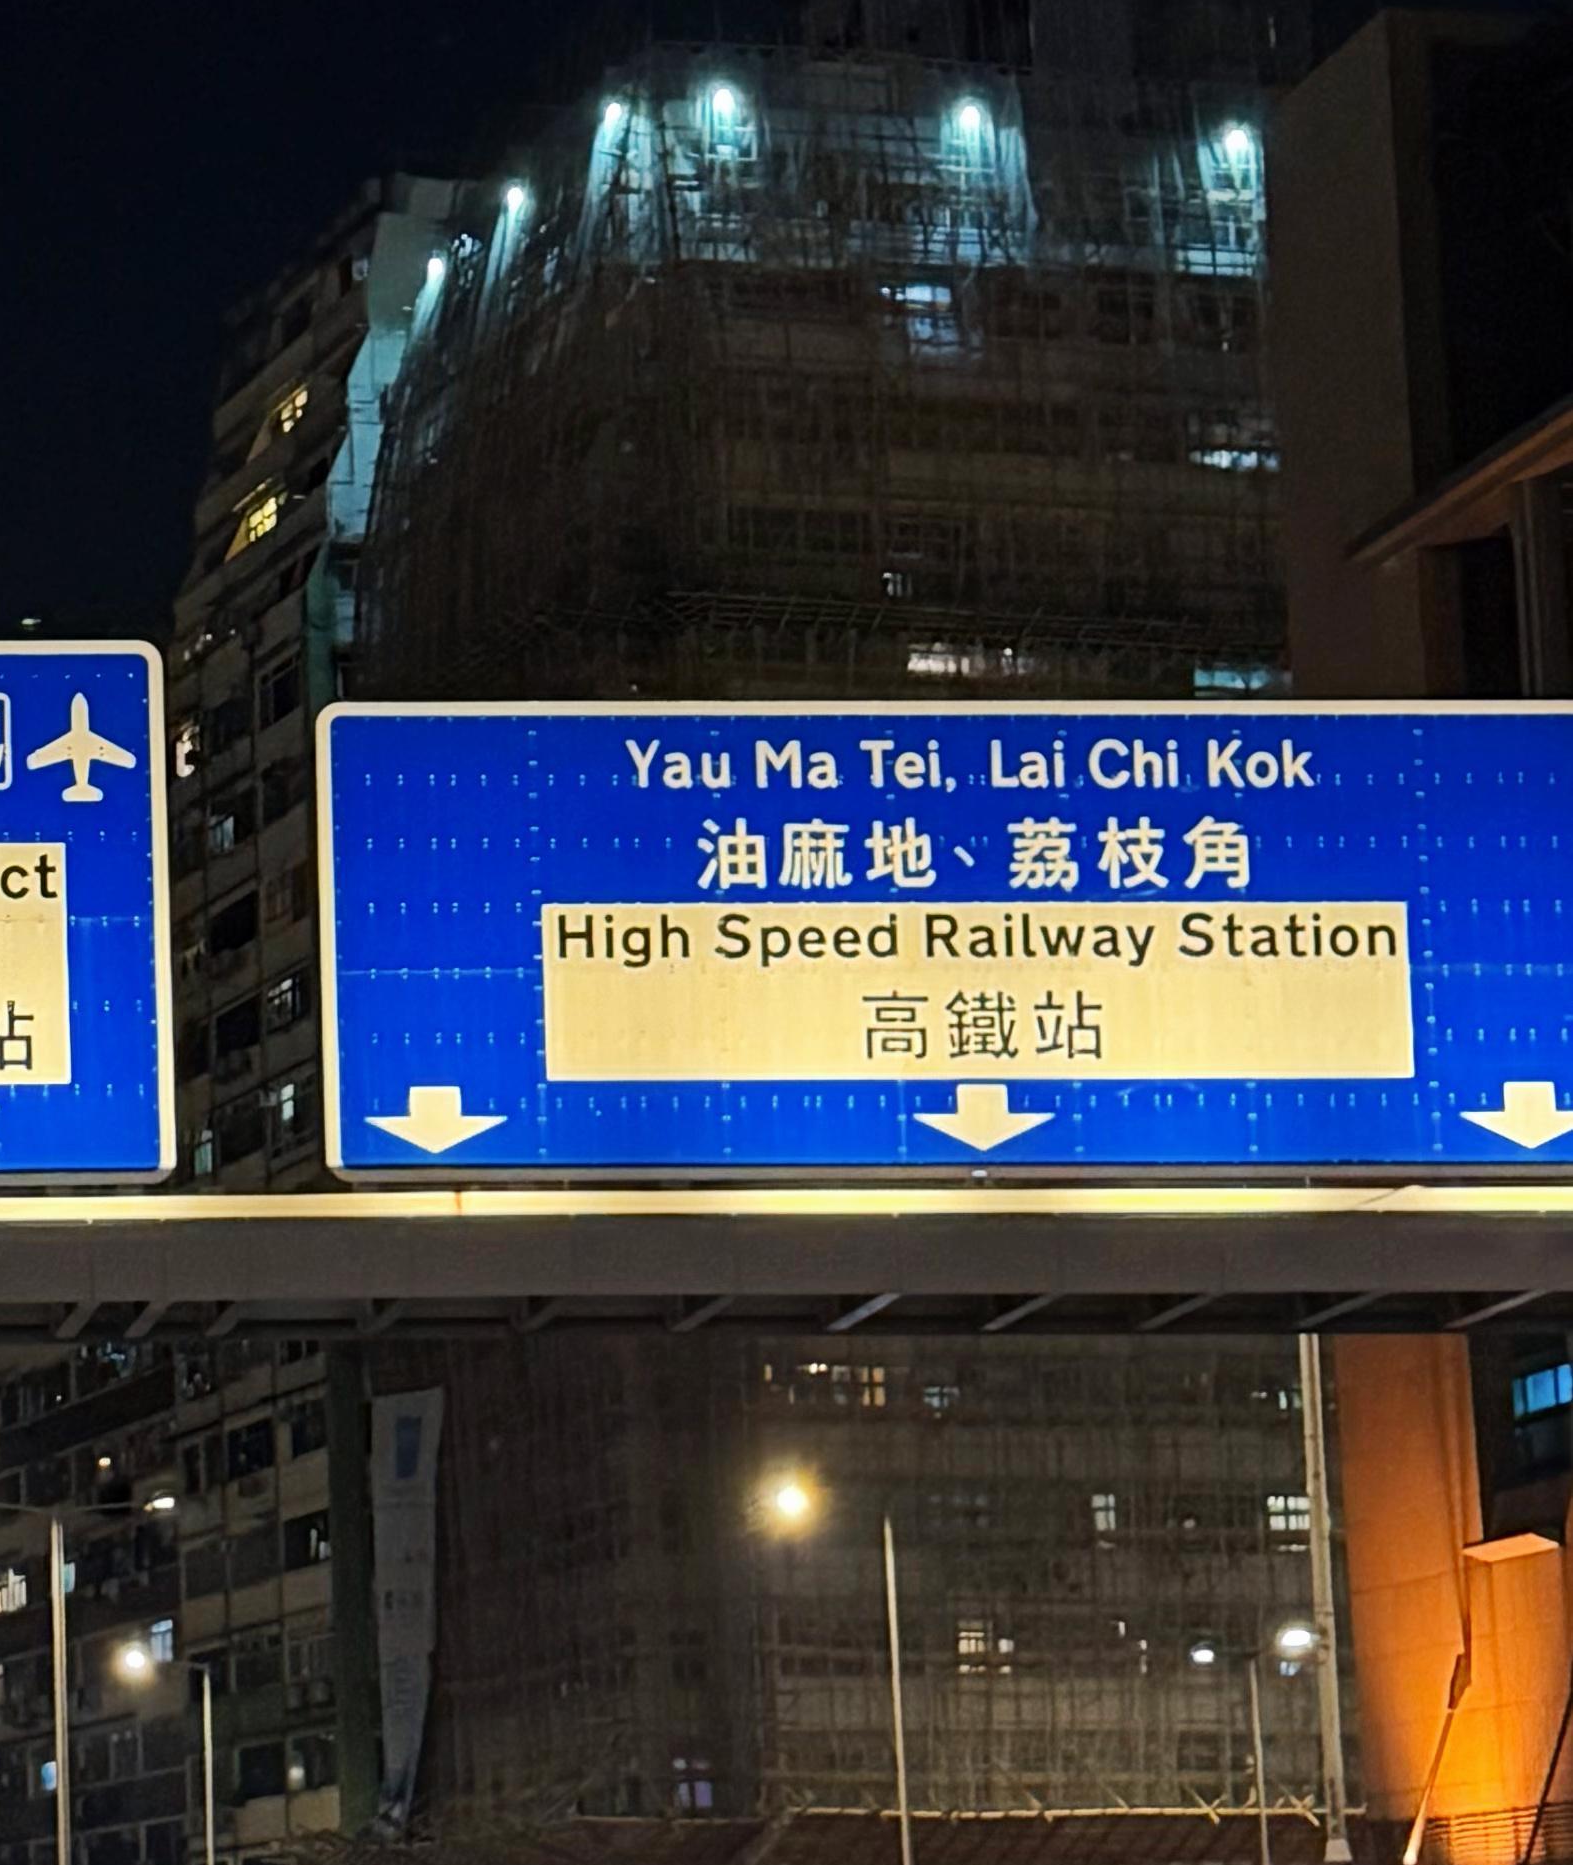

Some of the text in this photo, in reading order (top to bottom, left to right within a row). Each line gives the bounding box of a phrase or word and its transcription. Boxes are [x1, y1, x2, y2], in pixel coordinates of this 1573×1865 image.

[625, 738, 1315, 793] Yau Ma Tei, Lai Chi Kok
[558, 912, 1396, 968] High Speed Railway Station
[862, 990, 1102, 1059] 高鐵站
